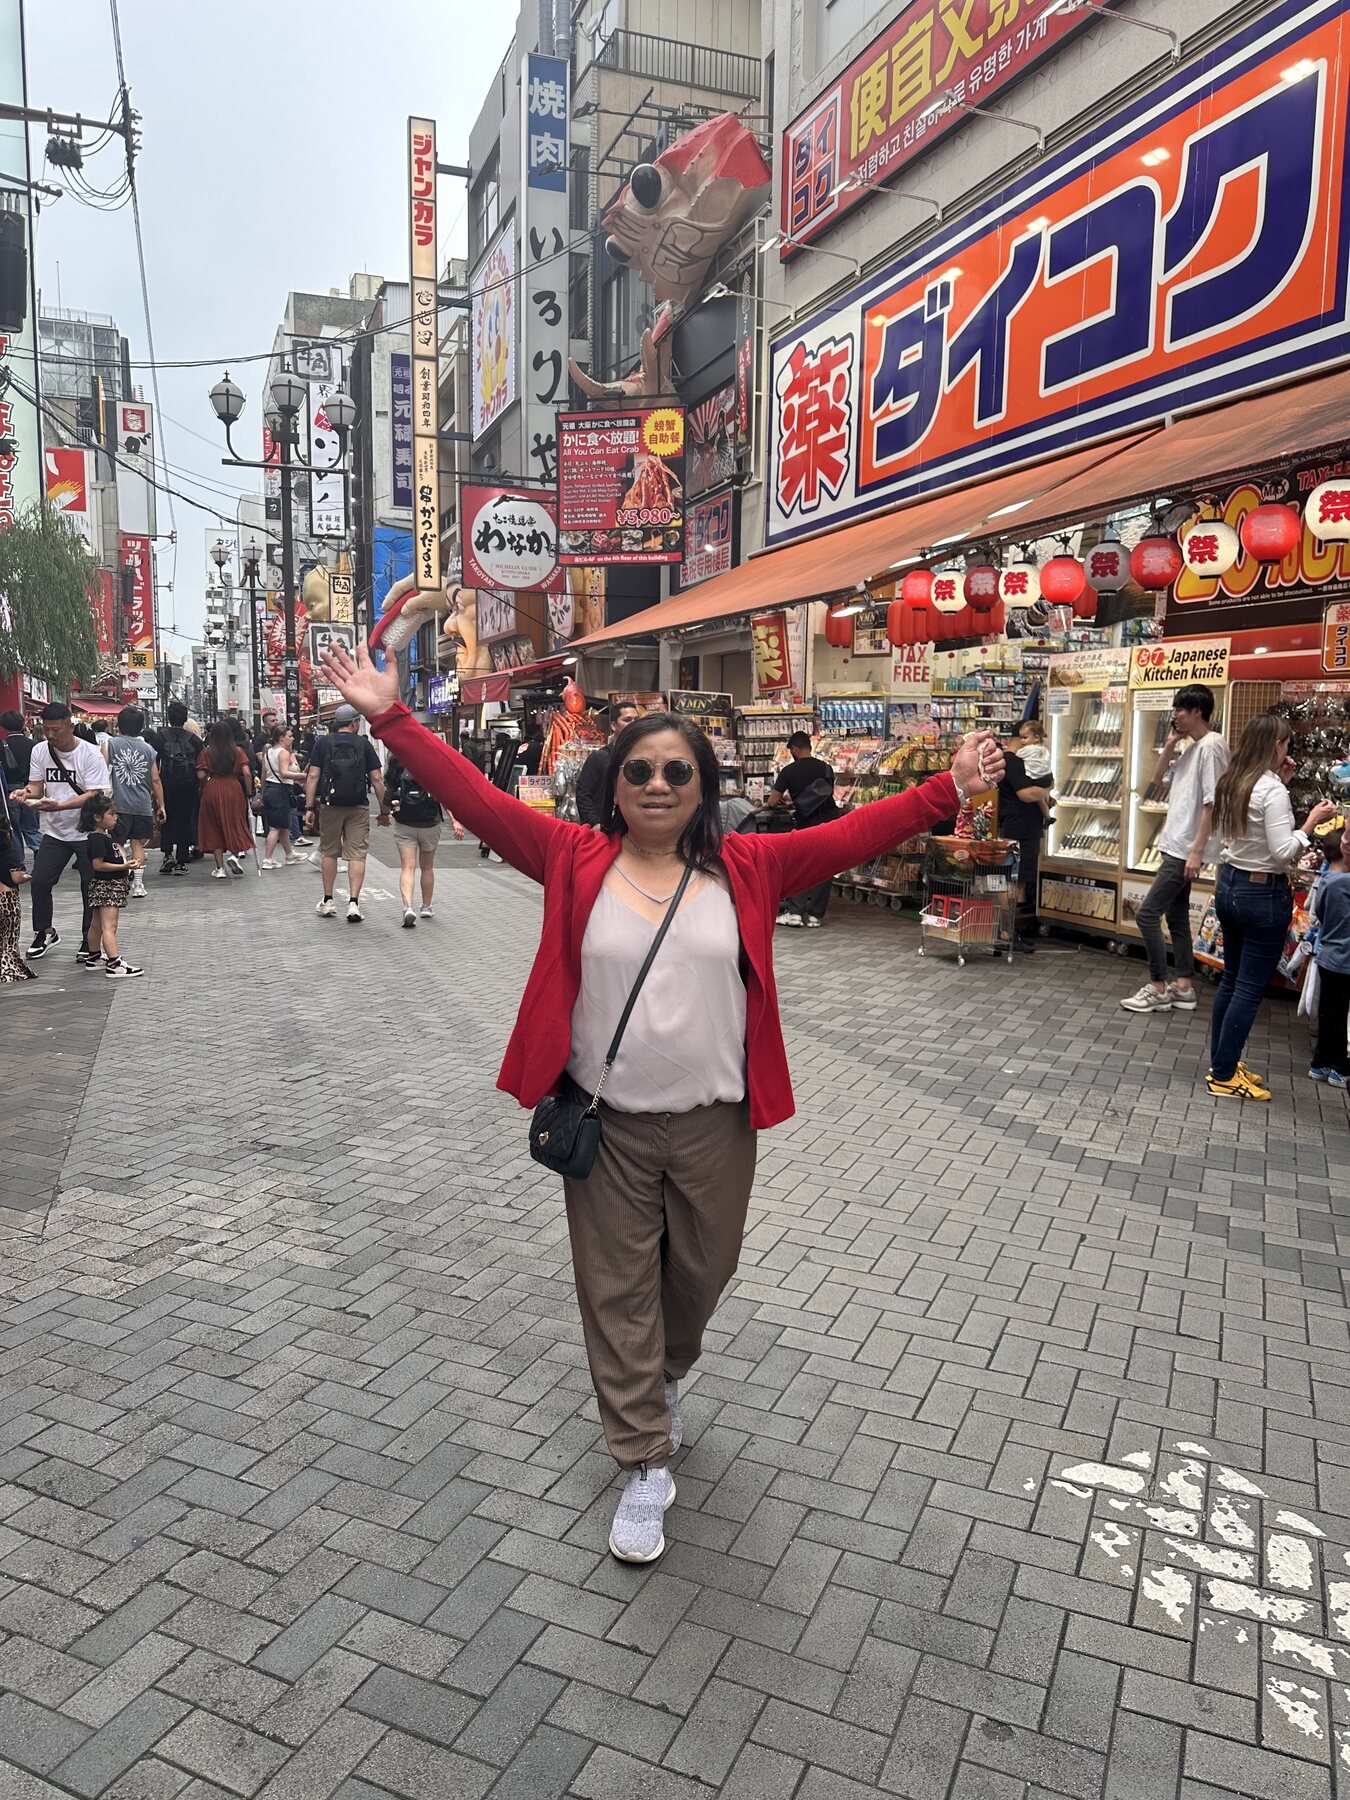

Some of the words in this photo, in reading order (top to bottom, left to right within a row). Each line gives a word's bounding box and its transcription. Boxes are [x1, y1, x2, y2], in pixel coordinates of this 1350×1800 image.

[903, 78, 966, 150] 친절하로
[968, 42, 1013, 94] 유명한
[1015, 14, 1049, 55] 가게
[528, 76, 566, 172] 焼肉
[413, 134, 434, 247] ジャンカラ
[778, 333, 854, 519] 薬
[871, 58, 1327, 469] ダイコク
[419, 366, 432, 428] 創業昭和四年
[562, 421, 576, 431] 元祖
[578, 419, 636, 430] 大阪かに食べ放題店
[653, 419, 676, 432] 螃蟹
[563, 430, 640, 447] かに食べ放題!
[649, 431, 681, 445] 自助餐
[563, 448, 572, 456] All
[573, 448, 588, 456] You
[589, 447, 604, 455] Can
[605, 446, 619, 454] Eat
[620, 445, 640, 453] Crab
[419, 485, 437, 579] 串かつだるま
[696, 499, 730, 554] ダイコク
[474, 520, 551, 556] わなか
[648, 554, 668, 562] building
[1188, 534, 1219, 564] 祭
[468, 558, 496, 588] TAKOYAKI
[681, 546, 730, 585] 免税专用楼层
[1090, 551, 1120, 578] 祭
[540, 566, 562, 590] WANAKA
[970, 572, 996, 596] 祭
[1003, 571, 1029, 596] 祭
[934, 578, 957, 601] 祭
[1221, 597, 1242, 605] products
[1259, 591, 1271, 600] able
[1284, 587, 1313, 596] discounted.
[858, 612, 876, 623] NMN
[132, 652, 147, 668] 薬
[898, 645, 928, 664] TAX
[1138, 647, 1165, 667] 包丁
[1168, 647, 1228, 666] Japanese
[893, 665, 931, 683] FREE
[1143, 665, 1188, 682] Kitchen
[1190, 662, 1224, 679] knife
[676, 697, 707, 710] NMN
[850, 727, 868, 735] CASIO
[47, 769, 77, 783] KIH
